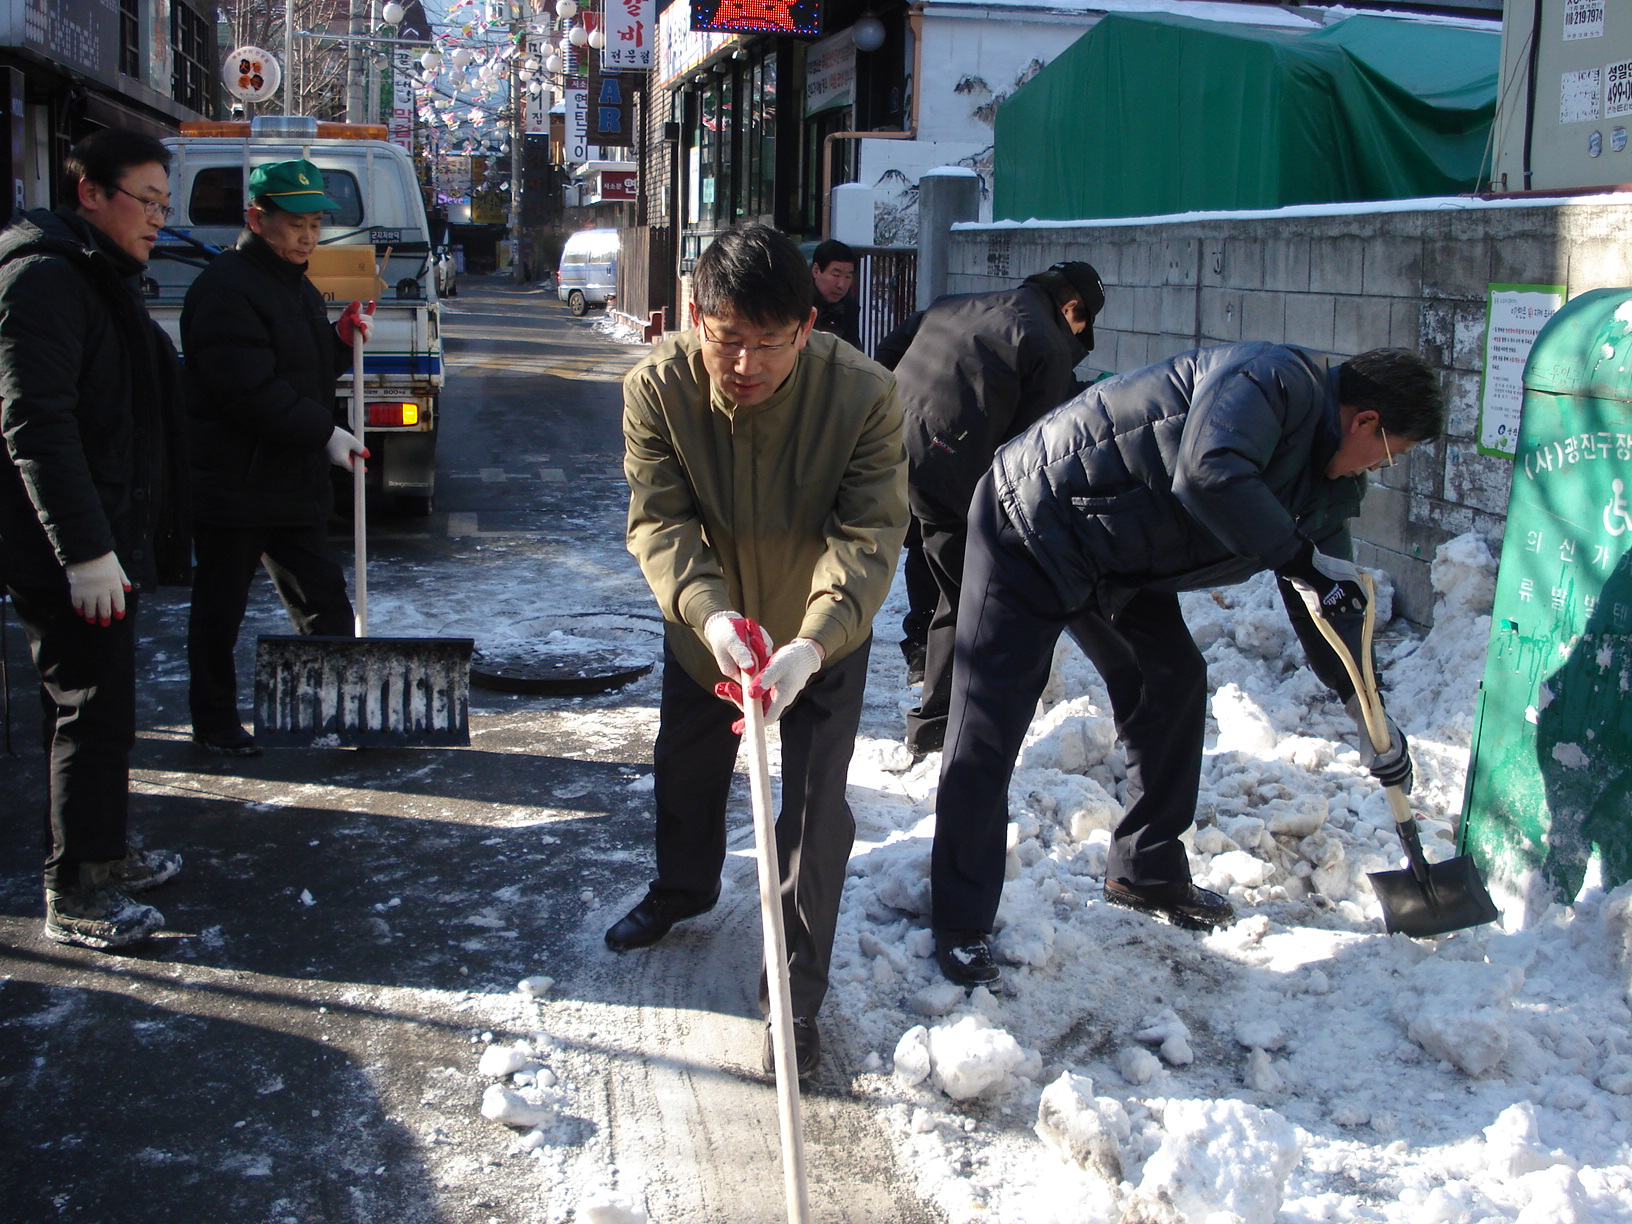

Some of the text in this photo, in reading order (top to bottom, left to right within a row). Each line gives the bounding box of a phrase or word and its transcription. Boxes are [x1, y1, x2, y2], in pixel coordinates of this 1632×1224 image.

[610, 49, 650, 65] 전문점
[597, 55, 622, 133] AR
[1607, 80, 1632, 104] 499-0
[574, 93, 588, 161] 연탄구이
